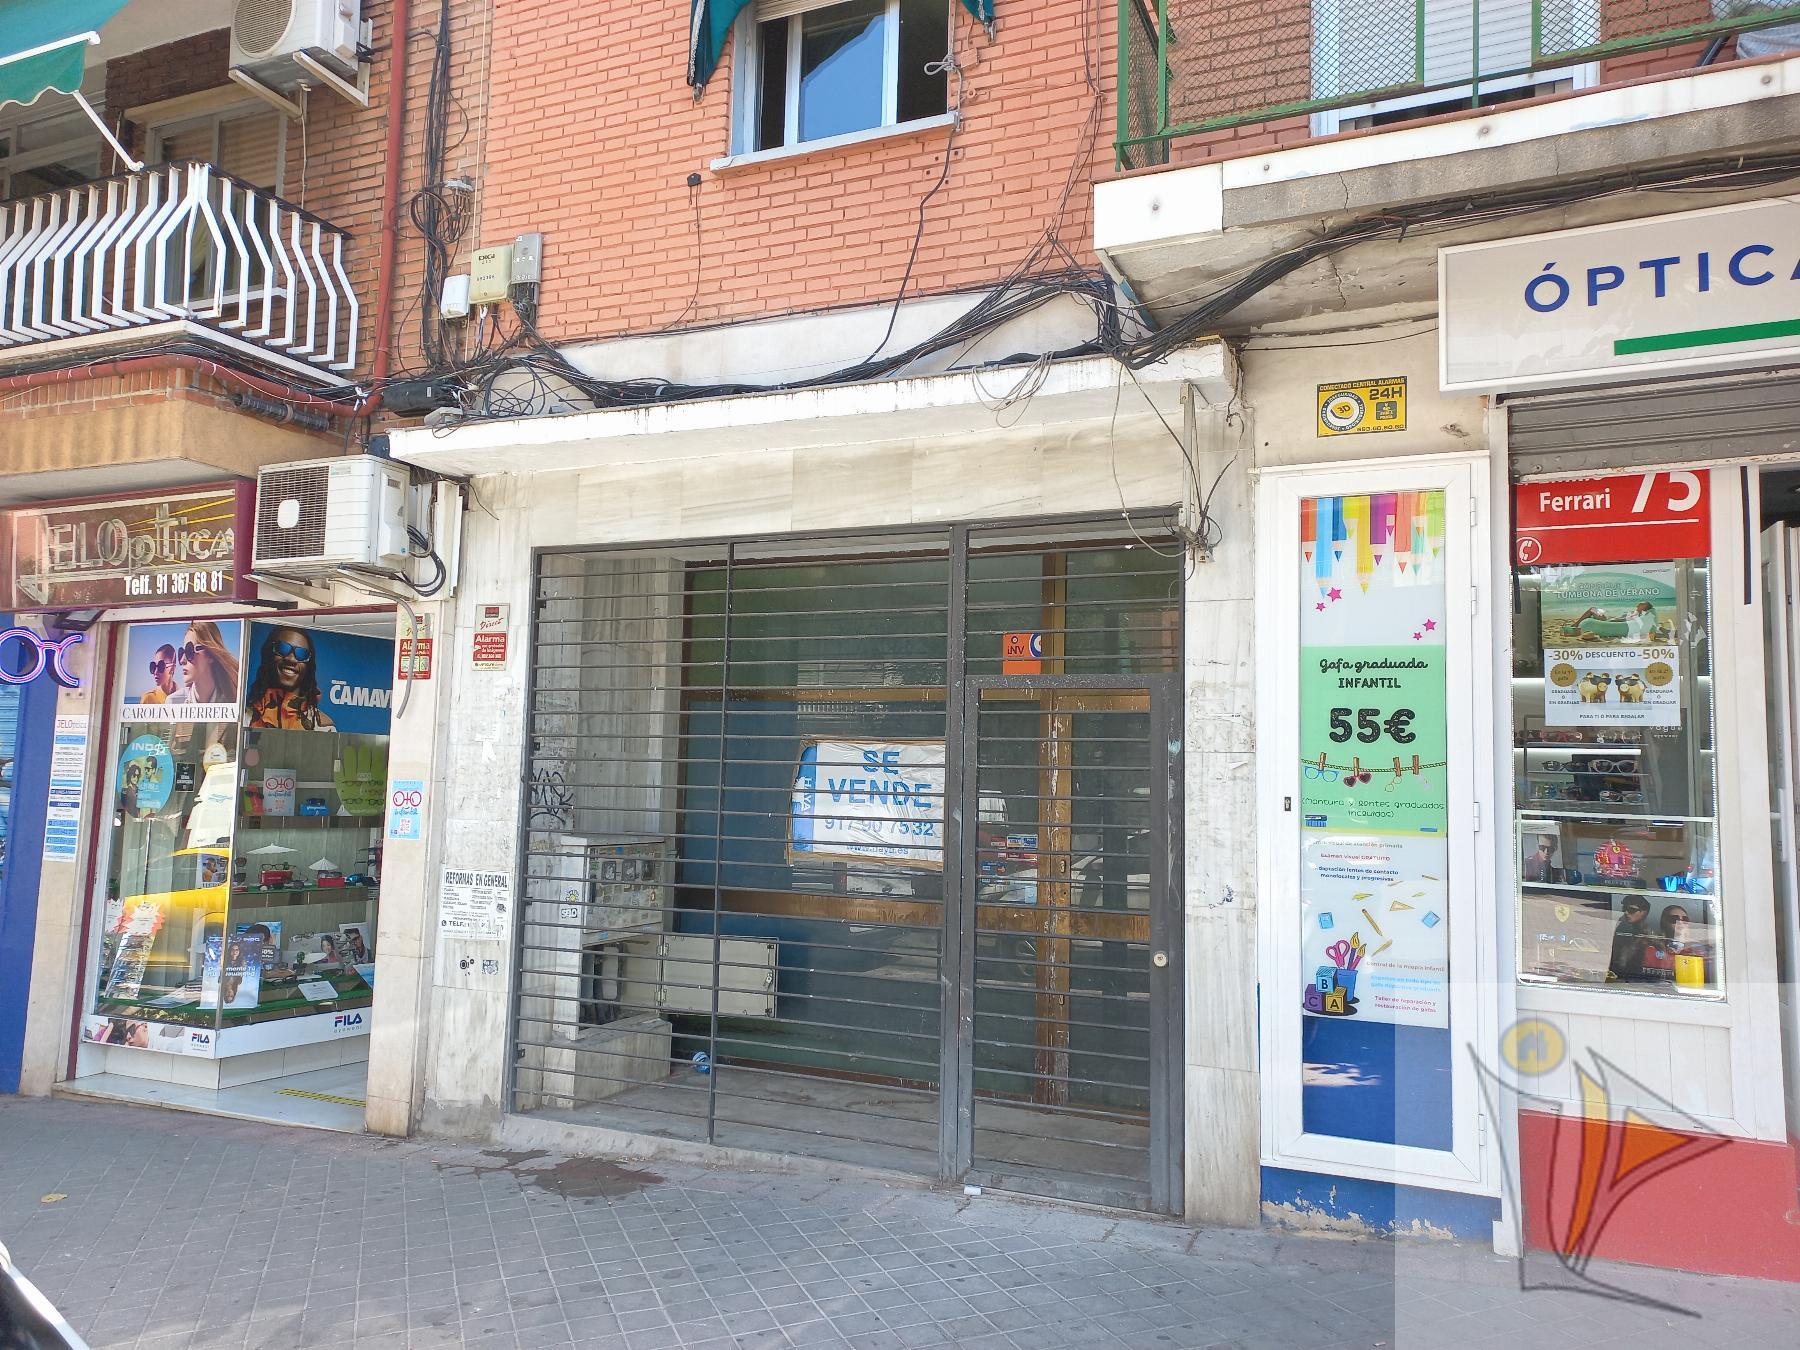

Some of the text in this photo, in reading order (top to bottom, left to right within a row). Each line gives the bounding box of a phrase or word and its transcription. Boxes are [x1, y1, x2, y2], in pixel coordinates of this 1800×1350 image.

[1378, 377, 1404, 386] ALARMAS
[1369, 386, 1402, 400] 24H
[1337, 405, 1351, 414] 3D
[1631, 471, 1702, 513] 75
[1539, 488, 1611, 513] Ferrari
[124, 570, 223, 595] Telf. 91 367 68 81
[1557, 587, 1660, 599] TUMBONA DE VERANO
[475, 635, 505, 643] Alarma
[1548, 648, 1675, 660] -30% DESCUENTO -50%
[1320, 657, 1429, 673] Gafa graduada
[1338, 677, 1402, 688] INFANTIL
[122, 706, 236, 719] CAROLINA HERRERA
[1329, 708, 1417, 744] 55€
[862, 750, 899, 774] SE
[828, 778, 932, 809] VENDE
[445, 871, 507, 889] REFORMAS EN GENERAL
[1321, 980, 1328, 990] B
[1308, 996, 1340, 1010] C A
[1400, 998, 1432, 1006] reparación
[334, 1012, 363, 1028] FILA
[191, 1032, 210, 1044] FILA
